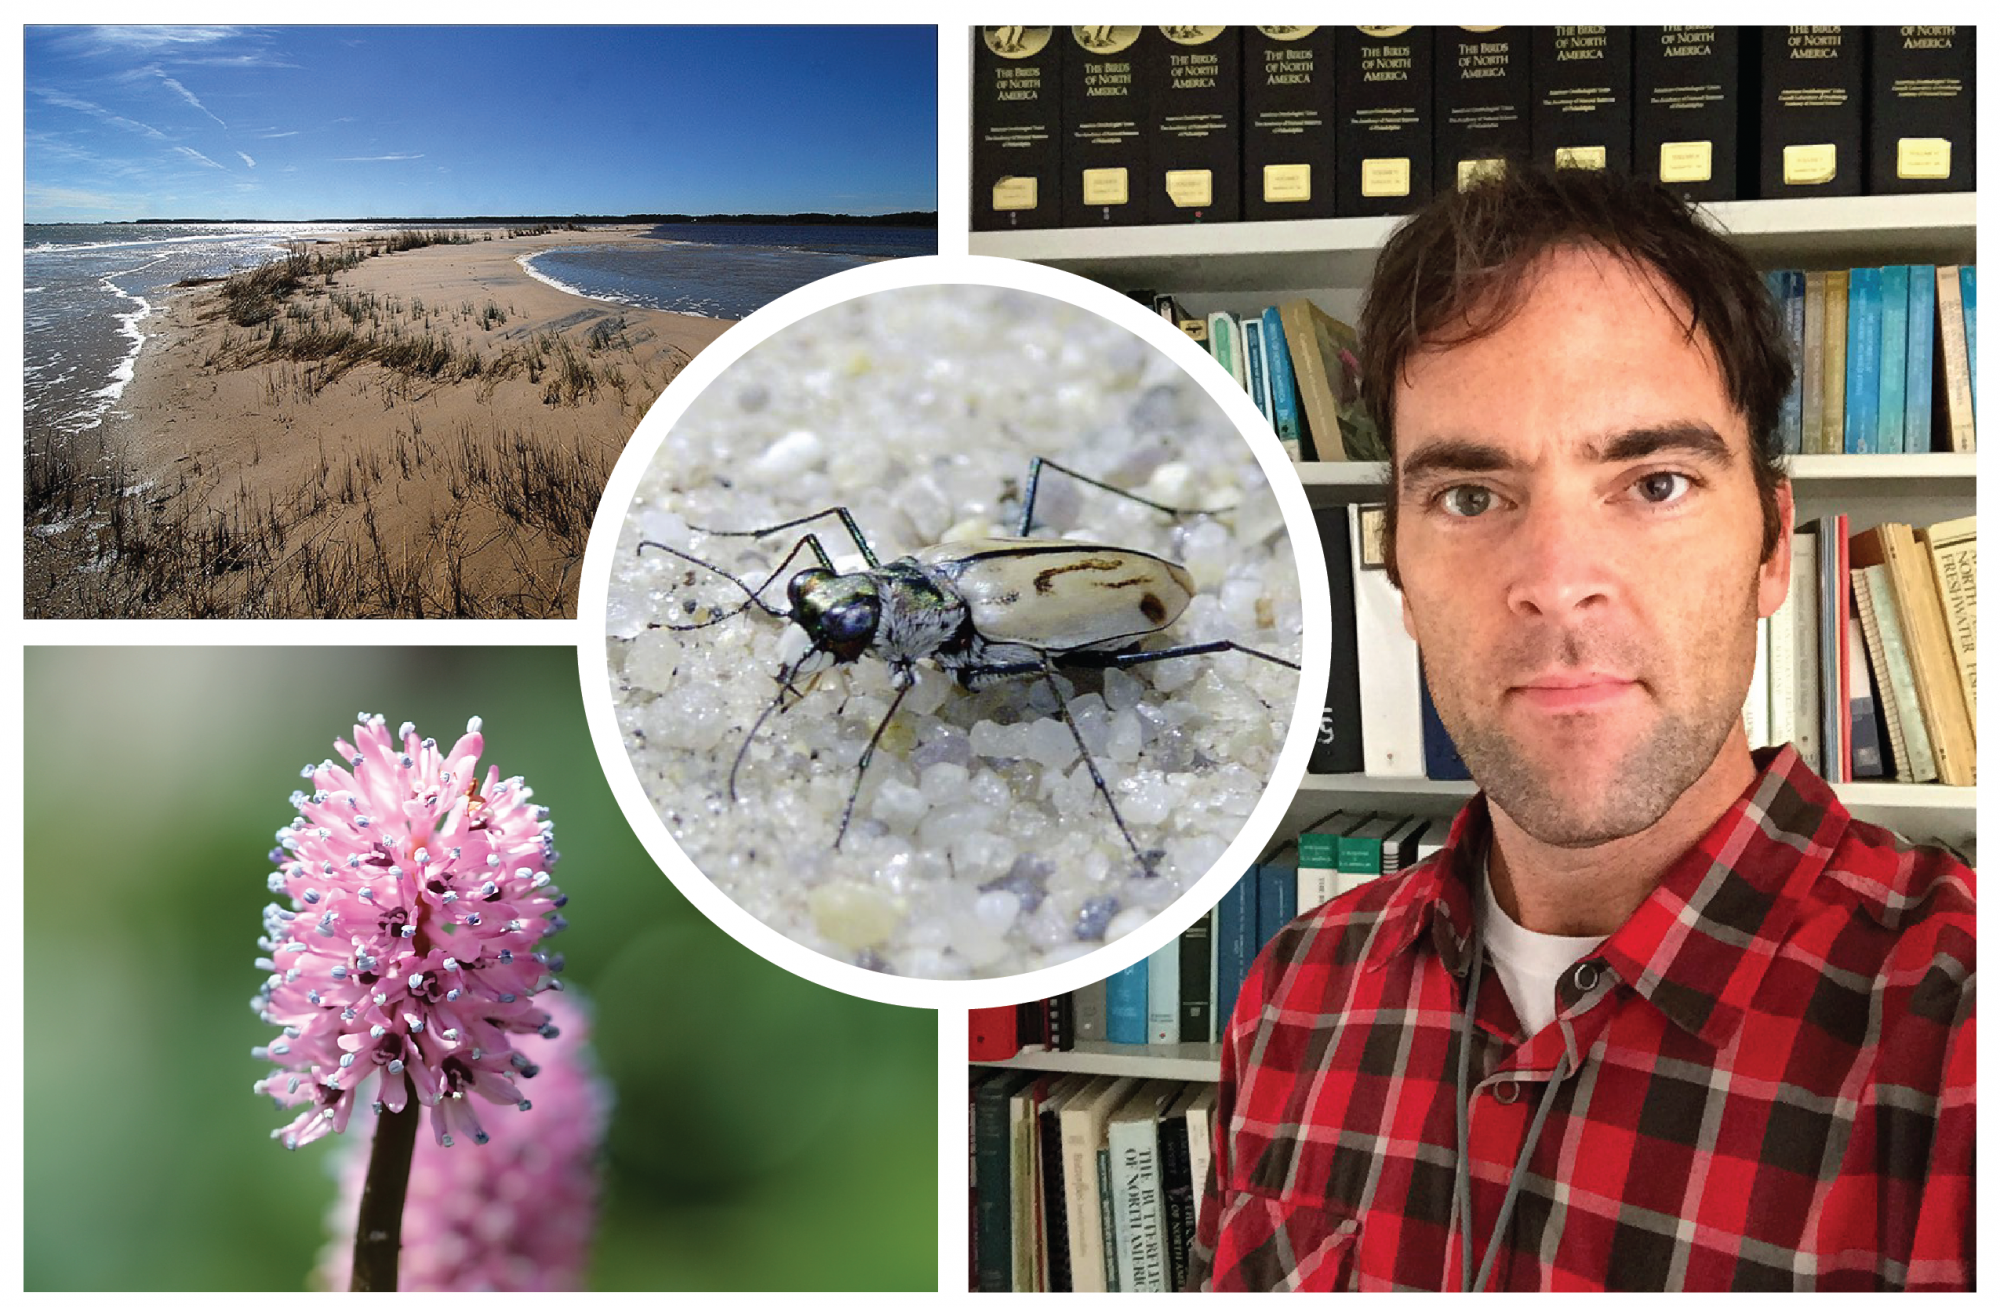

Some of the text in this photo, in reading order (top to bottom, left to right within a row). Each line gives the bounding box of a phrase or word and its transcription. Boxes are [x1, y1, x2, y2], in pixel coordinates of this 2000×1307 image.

[1555, 26, 1605, 36] THE BIRDS
[1901, 26, 1956, 36] OF NORTH
[1556, 37, 1606, 48] OF NORTH
[1662, 33, 1714, 44] OF NORTH
[1788, 35, 1841, 46] OF NORTH
[1903, 38, 1952, 48] AMERICA
[1362, 46, 1409, 57] THE BIRDS
[1459, 43, 1508, 54] THE BIRDS
[1664, 46, 1711, 56] AMERICA
[1790, 48, 1837, 58] AMERICA
[1171, 55, 1217, 65] THE BIRDS
[1265, 50, 1312, 60] THE BIRDS
[1557, 50, 1603, 60] AMERICA
[1362, 59, 1411, 69] OF NORTH
[1459, 56, 1508, 66] OF NORTH
[1085, 63, 1130, 73] THE BIRDS
[1171, 66, 1218, 76] OF NORTH
[1266, 62, 1313, 72] OF NORTH
[996, 68, 1040, 78] THE BIRDS
[1364, 72, 1407, 81] AMERICA
[1461, 68, 1505, 78] AMERICA
[1010, 80, 1040, 88] NORTH
[1085, 75, 1131, 85] OF NORTH
[1172, 78, 1215, 88] AMERICA
[1268, 74, 1310, 84] AMERICA
[998, 91, 1037, 100] AMERICA
[1087, 87, 1127, 96] AMERICA
[1956, 550, 1977, 607] NORTH
[1942, 553, 1975, 654] FRESHWATER
[1139, 1149, 1153, 1183] THE
[1125, 1148, 1147, 1292] OF NORTH AMERIC
